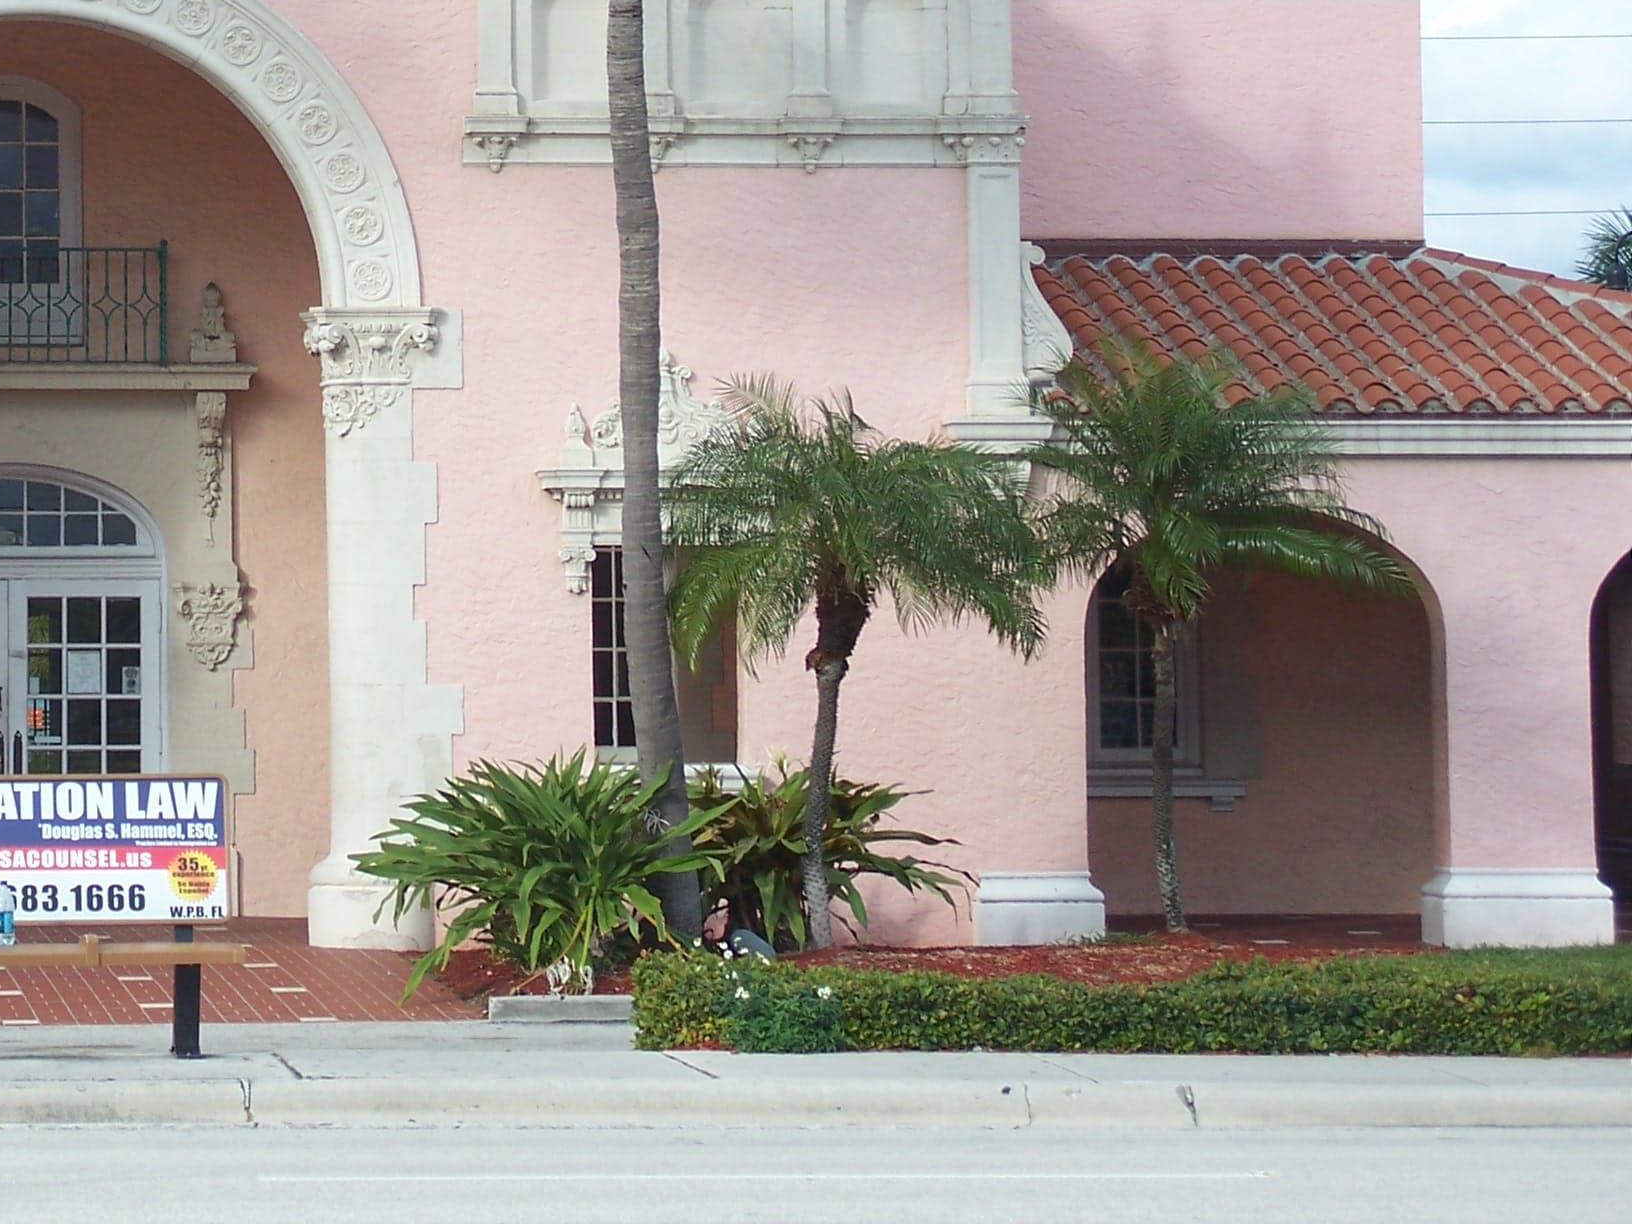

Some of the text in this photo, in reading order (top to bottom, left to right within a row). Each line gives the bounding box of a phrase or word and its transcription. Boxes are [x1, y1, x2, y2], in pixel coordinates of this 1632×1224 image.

[125, 781, 218, 820] LAW
[105, 823, 118, 839] S.
[120, 823, 185, 840] Hammel,
[187, 823, 218, 841] ESQ.
[178, 857, 199, 871] 35
[170, 905, 208, 918] W.P.B.
